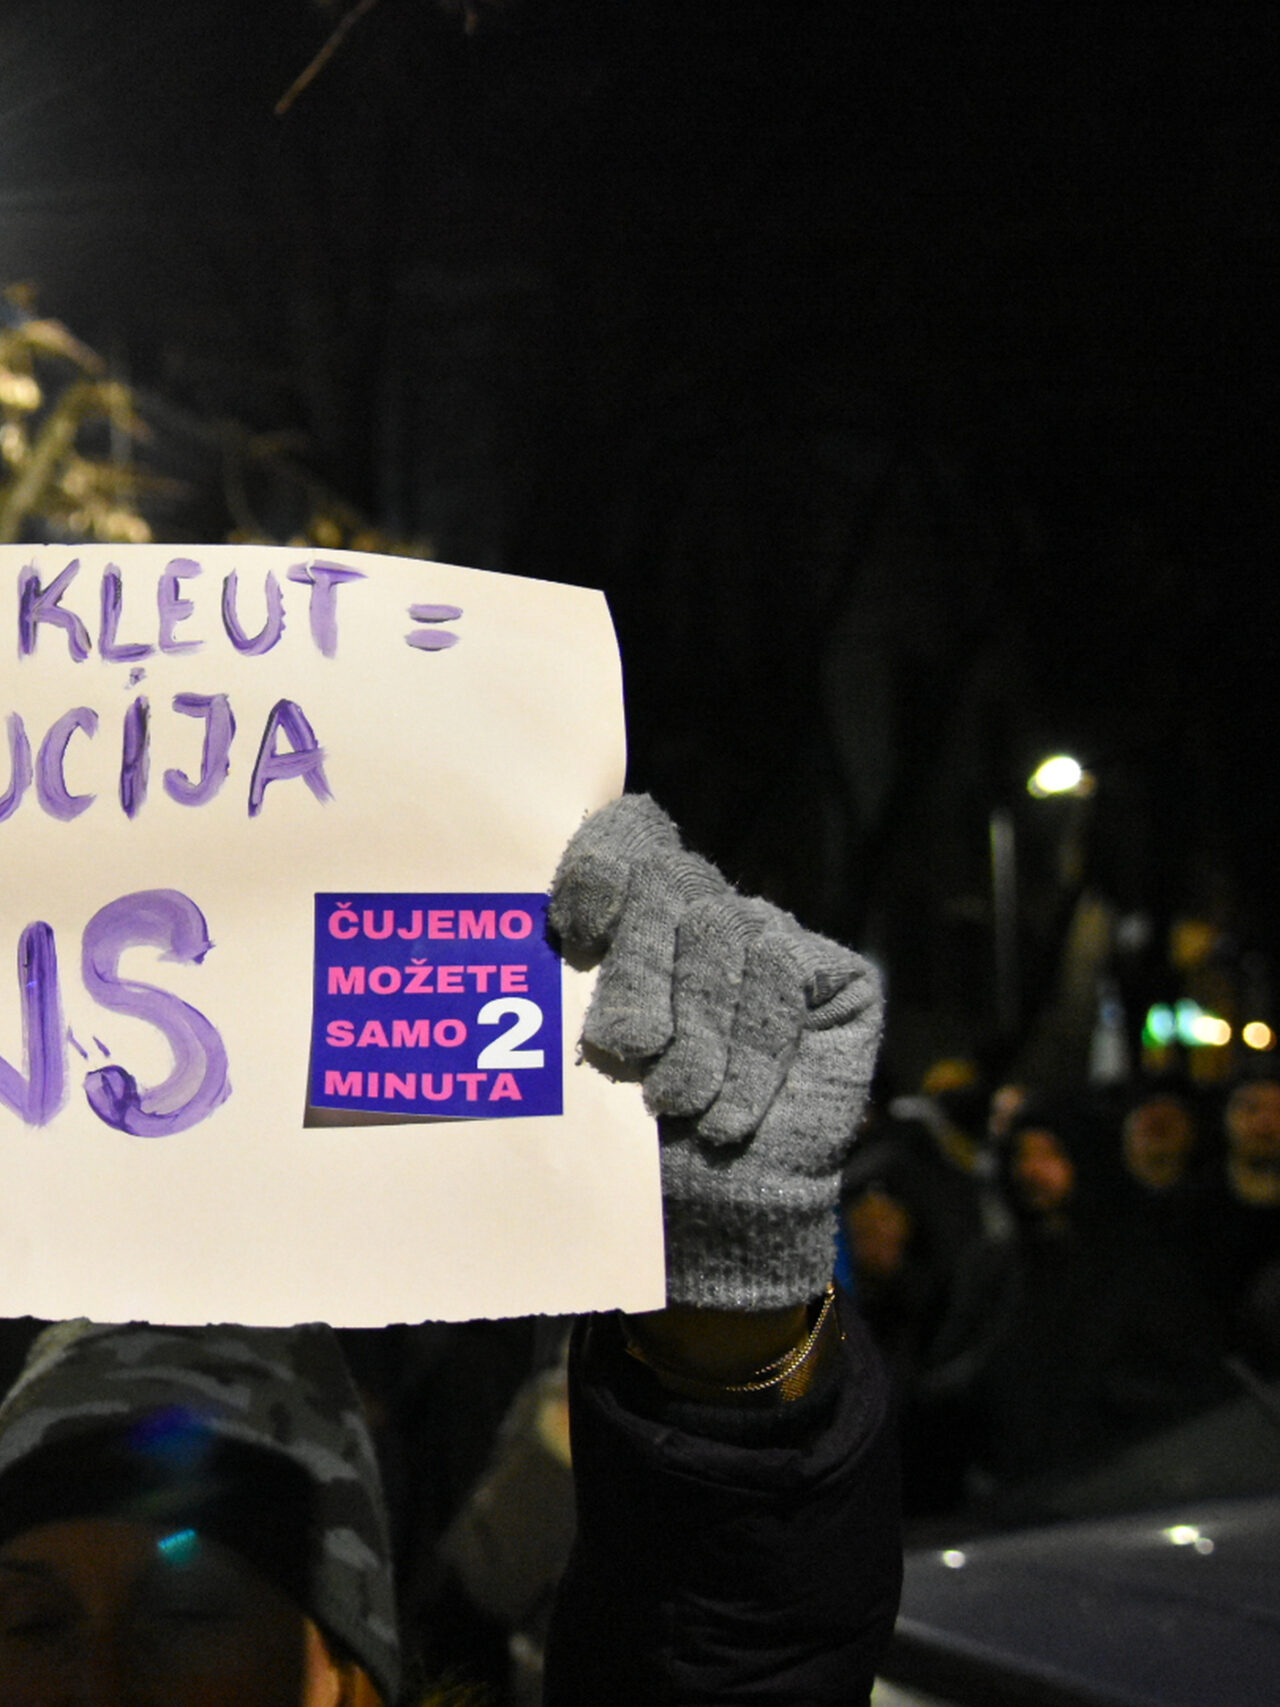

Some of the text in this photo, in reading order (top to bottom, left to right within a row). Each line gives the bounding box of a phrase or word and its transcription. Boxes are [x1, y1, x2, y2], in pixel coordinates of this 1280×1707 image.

[18, 557, 368, 662] KLEUT
[405, 603, 463, 651] =
[328, 902, 533, 939] ČUJEMO
[328, 958, 529, 995] MOŽETE
[326, 997, 545, 1069] SAMO 2
[324, 1070, 522, 1102] MINUTA
